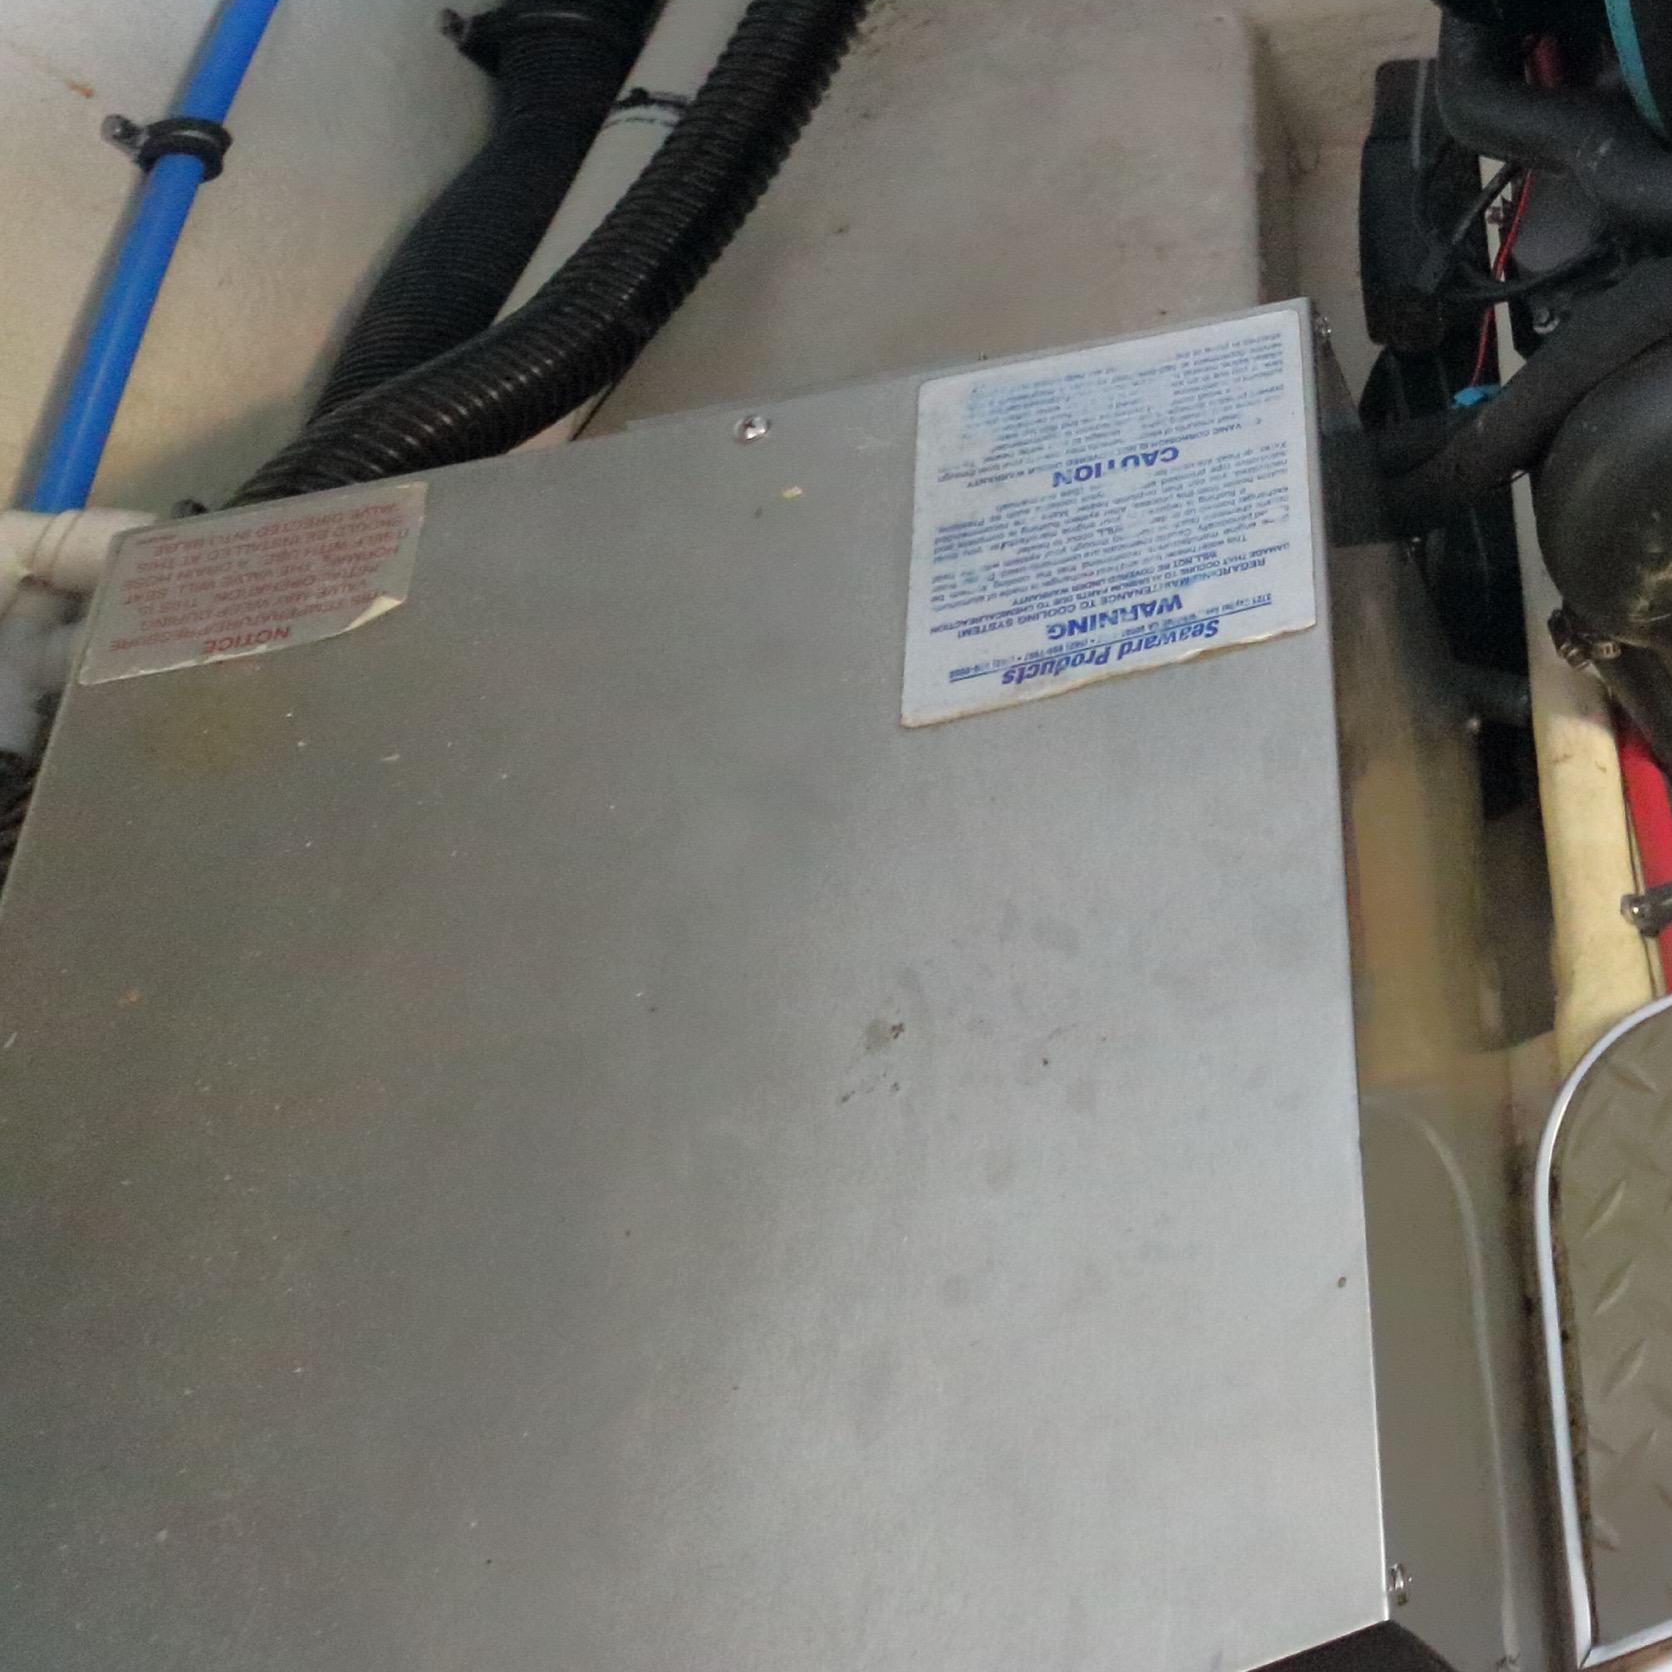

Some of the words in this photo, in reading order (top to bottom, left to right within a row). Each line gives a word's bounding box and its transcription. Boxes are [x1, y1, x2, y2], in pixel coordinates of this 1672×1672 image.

[1249, 542, 1290, 559] DAMAGE
[1190, 557, 1266, 584] REGARDING
[1077, 597, 1095, 610] TO
[1097, 575, 1190, 605] MAINTENANCE
[1015, 602, 1075, 625] COOLING
[1045, 594, 1183, 641] WARNING
[199, 625, 291, 654] NOTICE
[956, 617, 1013, 639] SYSTEM!
[1115, 618, 1221, 660] Seaward
[1000, 644, 1114, 687] Products
